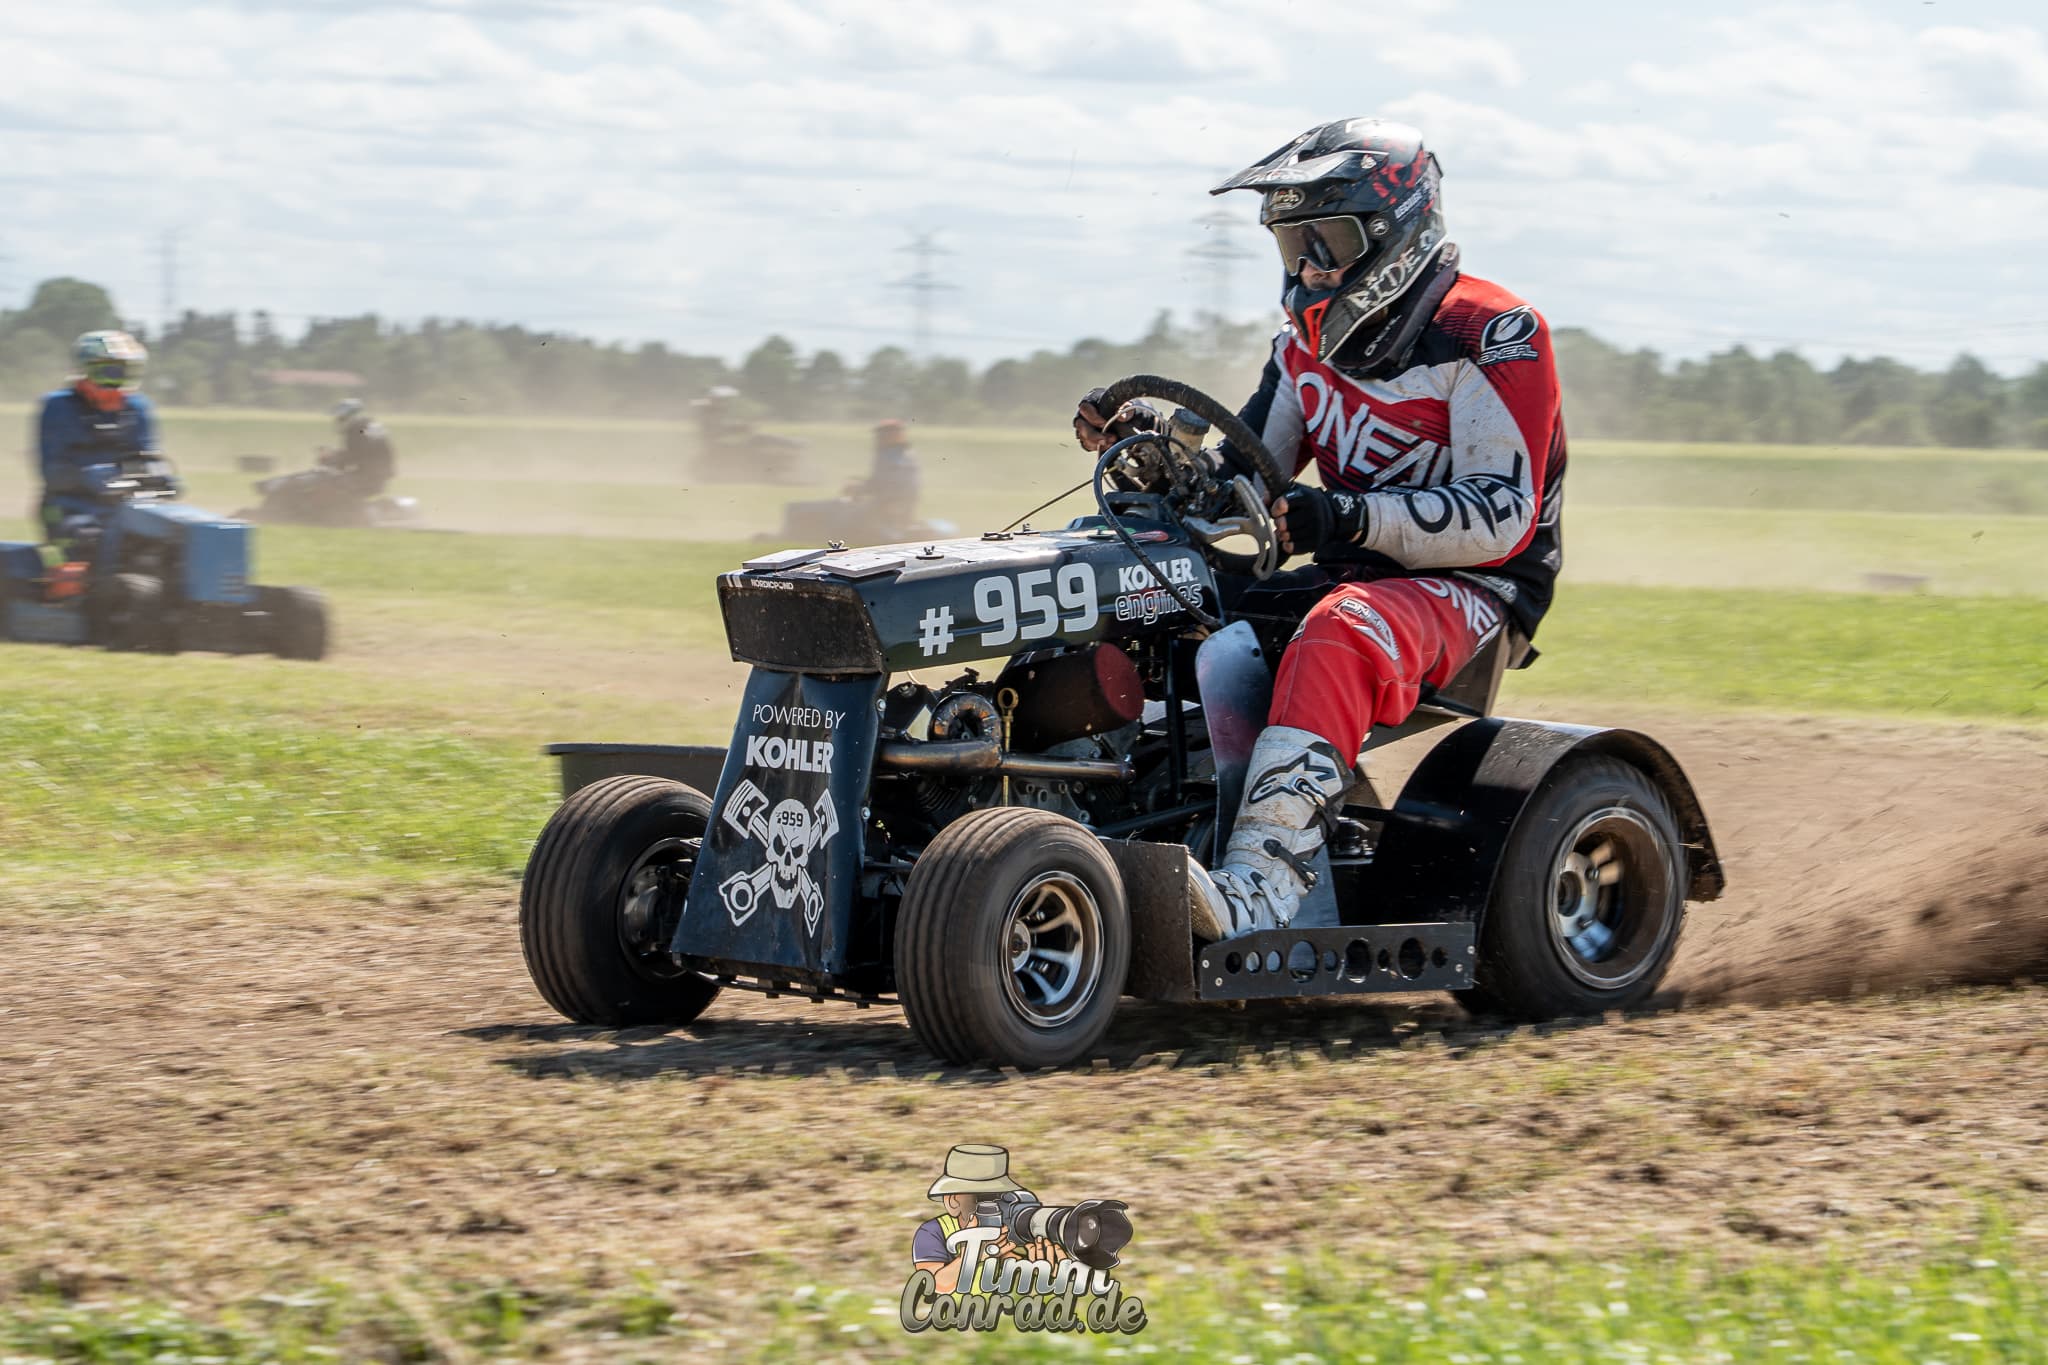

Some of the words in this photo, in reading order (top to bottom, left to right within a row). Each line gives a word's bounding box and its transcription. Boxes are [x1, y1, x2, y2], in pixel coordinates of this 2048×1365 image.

[919, 606, 954, 656] #
[973, 562, 1099, 647] 959
[752, 704, 821, 728] POWERED
[825, 711, 846, 729] BY
[745, 735, 834, 774] KOHLER
